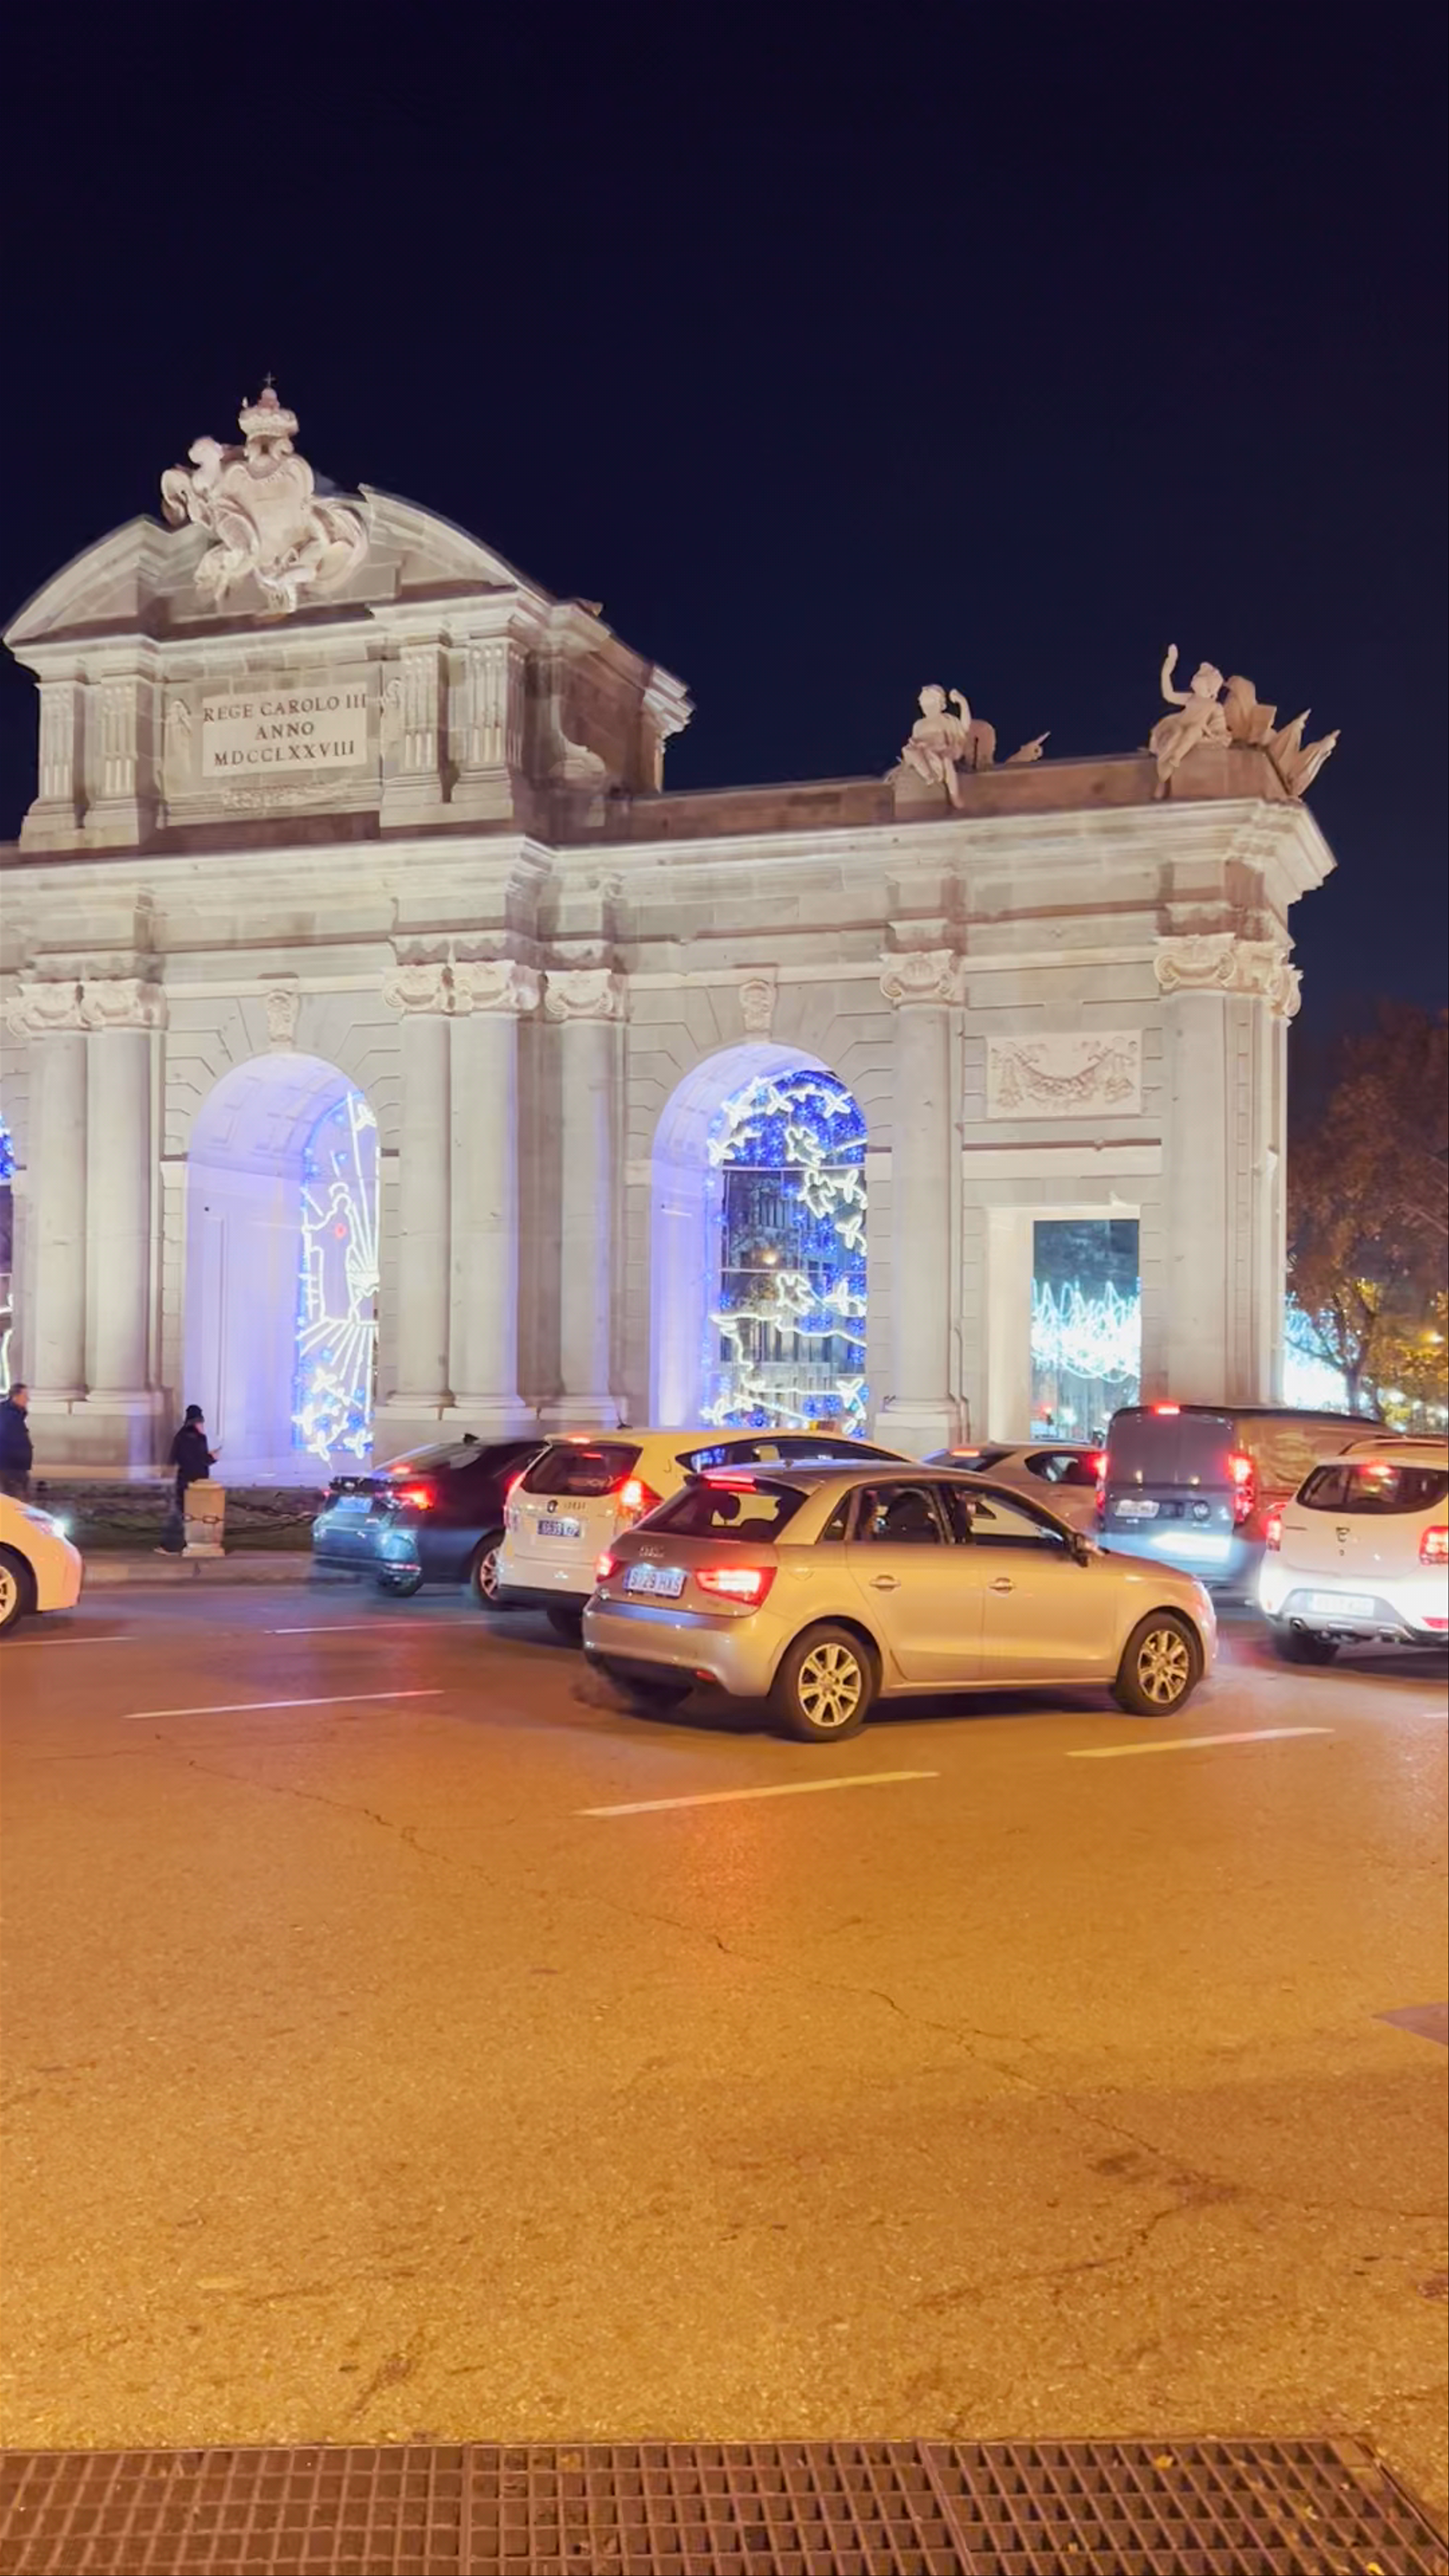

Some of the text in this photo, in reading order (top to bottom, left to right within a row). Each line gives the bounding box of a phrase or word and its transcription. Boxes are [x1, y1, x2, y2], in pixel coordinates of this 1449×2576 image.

[203, 694, 366, 722] REGE CAROLO III
[255, 721, 314, 740] ANNO
[214, 740, 354, 766] MDCCLXXVIII
